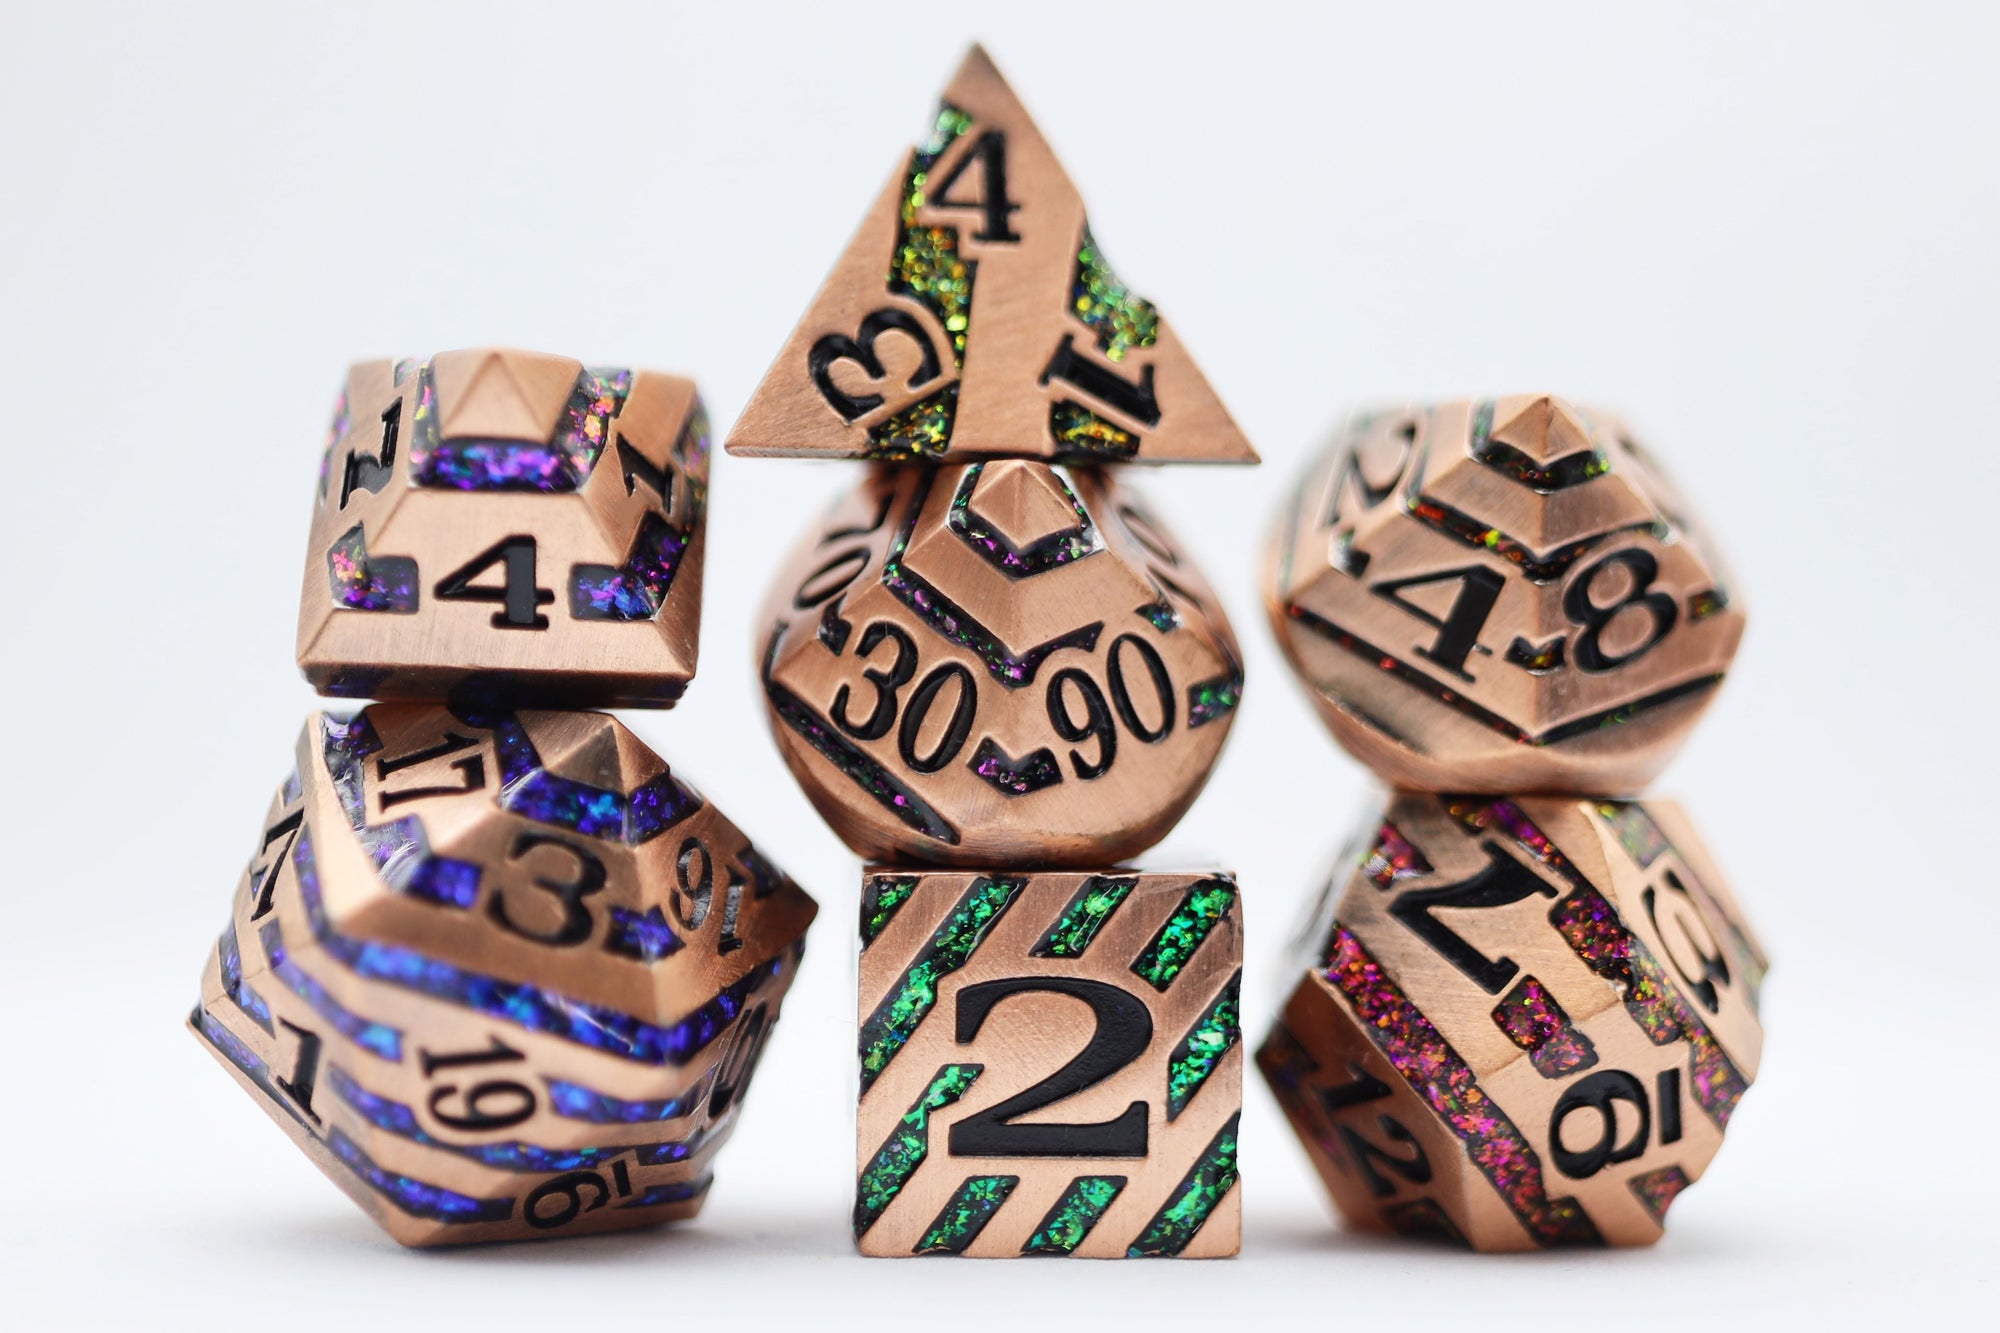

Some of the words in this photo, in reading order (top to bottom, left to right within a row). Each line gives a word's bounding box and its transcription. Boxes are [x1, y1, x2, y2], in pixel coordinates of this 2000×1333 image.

[925, 128, 1023, 244] 4
[807, 307, 943, 425] 3
[1037, 332, 1163, 428] 1
[433, 533, 556, 629] 4
[1368, 563, 1508, 684] 4
[1562, 546, 1679, 674] 8
[829, 619, 977, 775] 30
[1045, 633, 1176, 781] 90
[376, 731, 486, 814] 17
[484, 830, 608, 947] 3
[1387, 839, 1560, 996] 7
[276, 1014, 323, 1128] 1
[418, 1033, 537, 1133] 19
[948, 976, 1153, 1157] 2
[1309, 1060, 1434, 1198] 12
